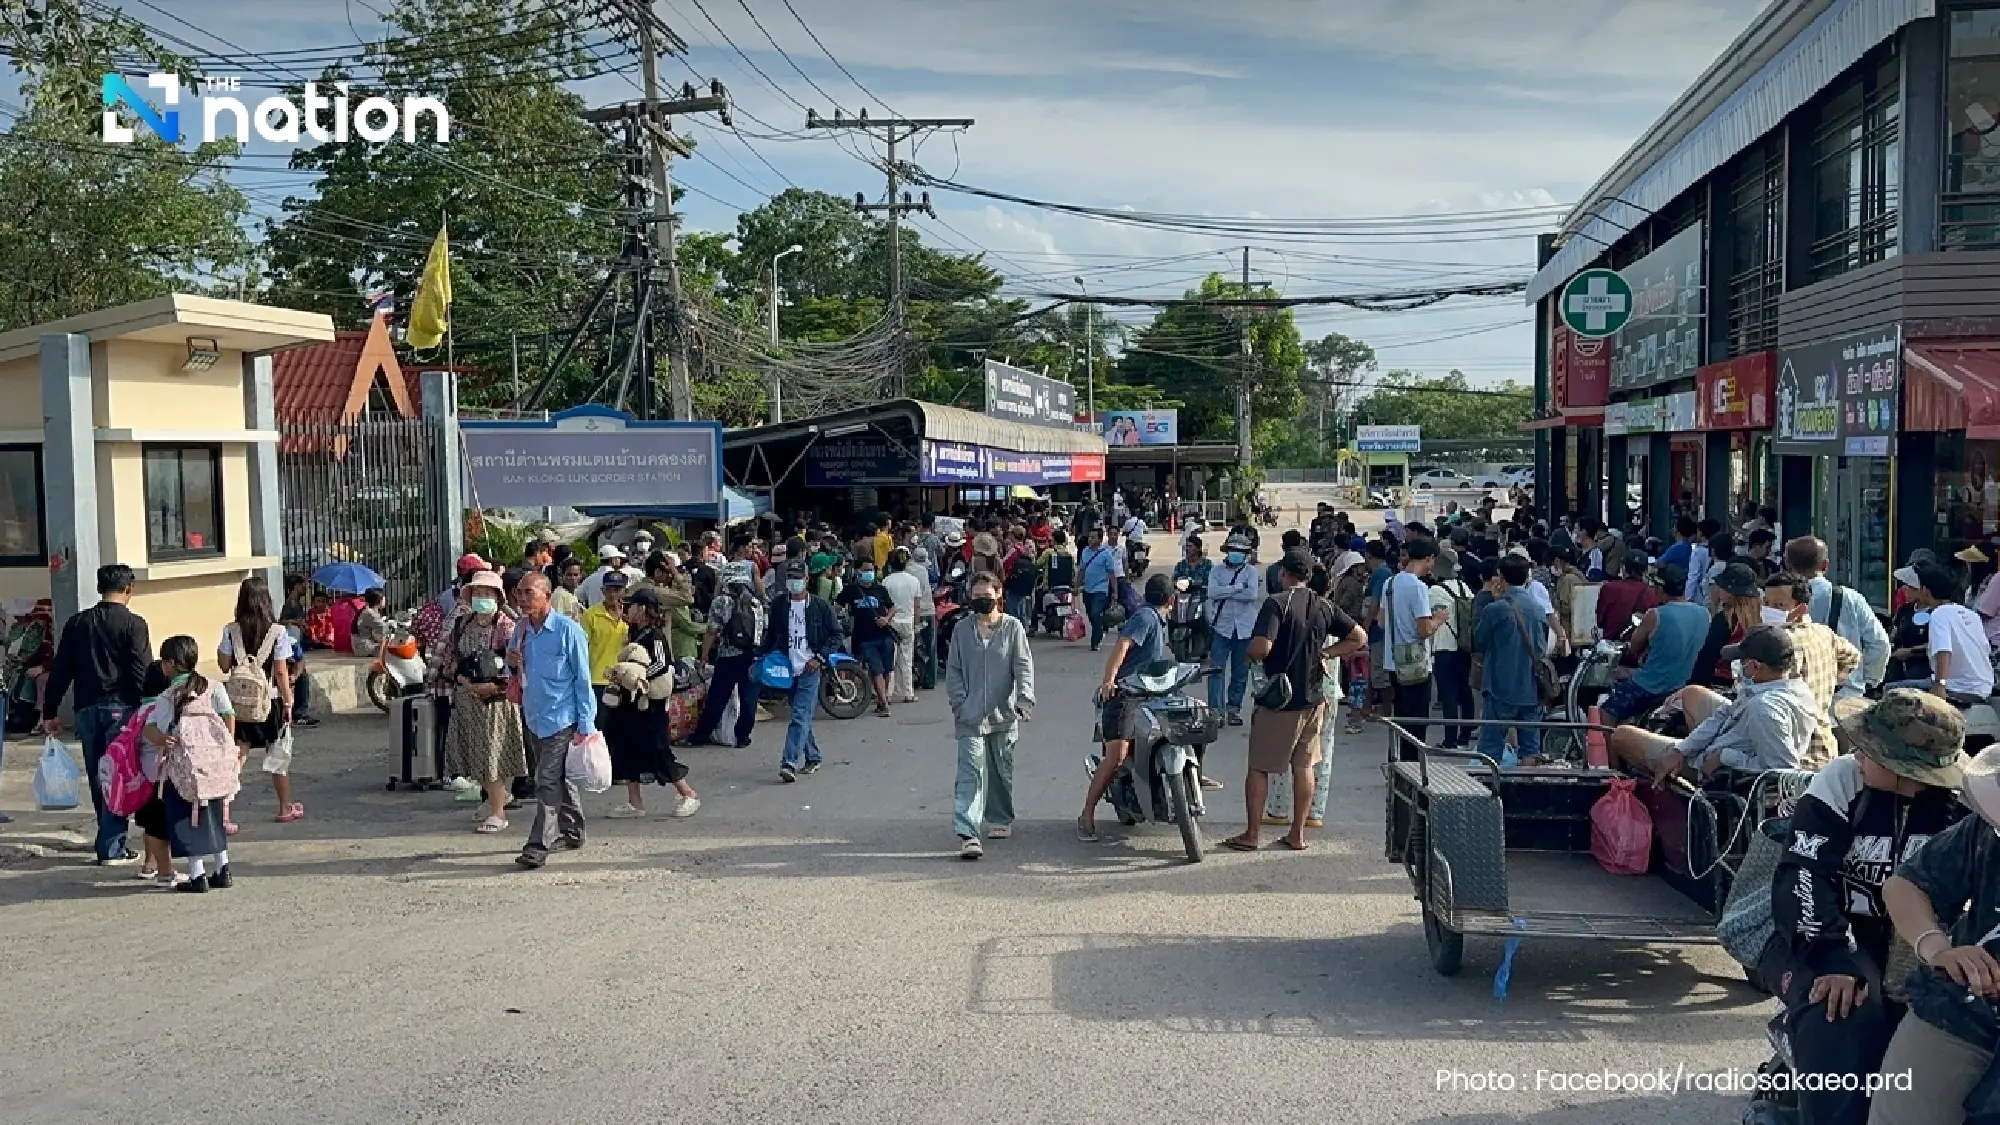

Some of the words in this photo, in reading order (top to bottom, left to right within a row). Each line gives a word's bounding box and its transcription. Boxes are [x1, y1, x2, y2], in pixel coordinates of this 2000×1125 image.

[1145, 422, 1169, 434] 5G
[591, 473, 636, 483] BORDER
[637, 472, 681, 483] STATION
